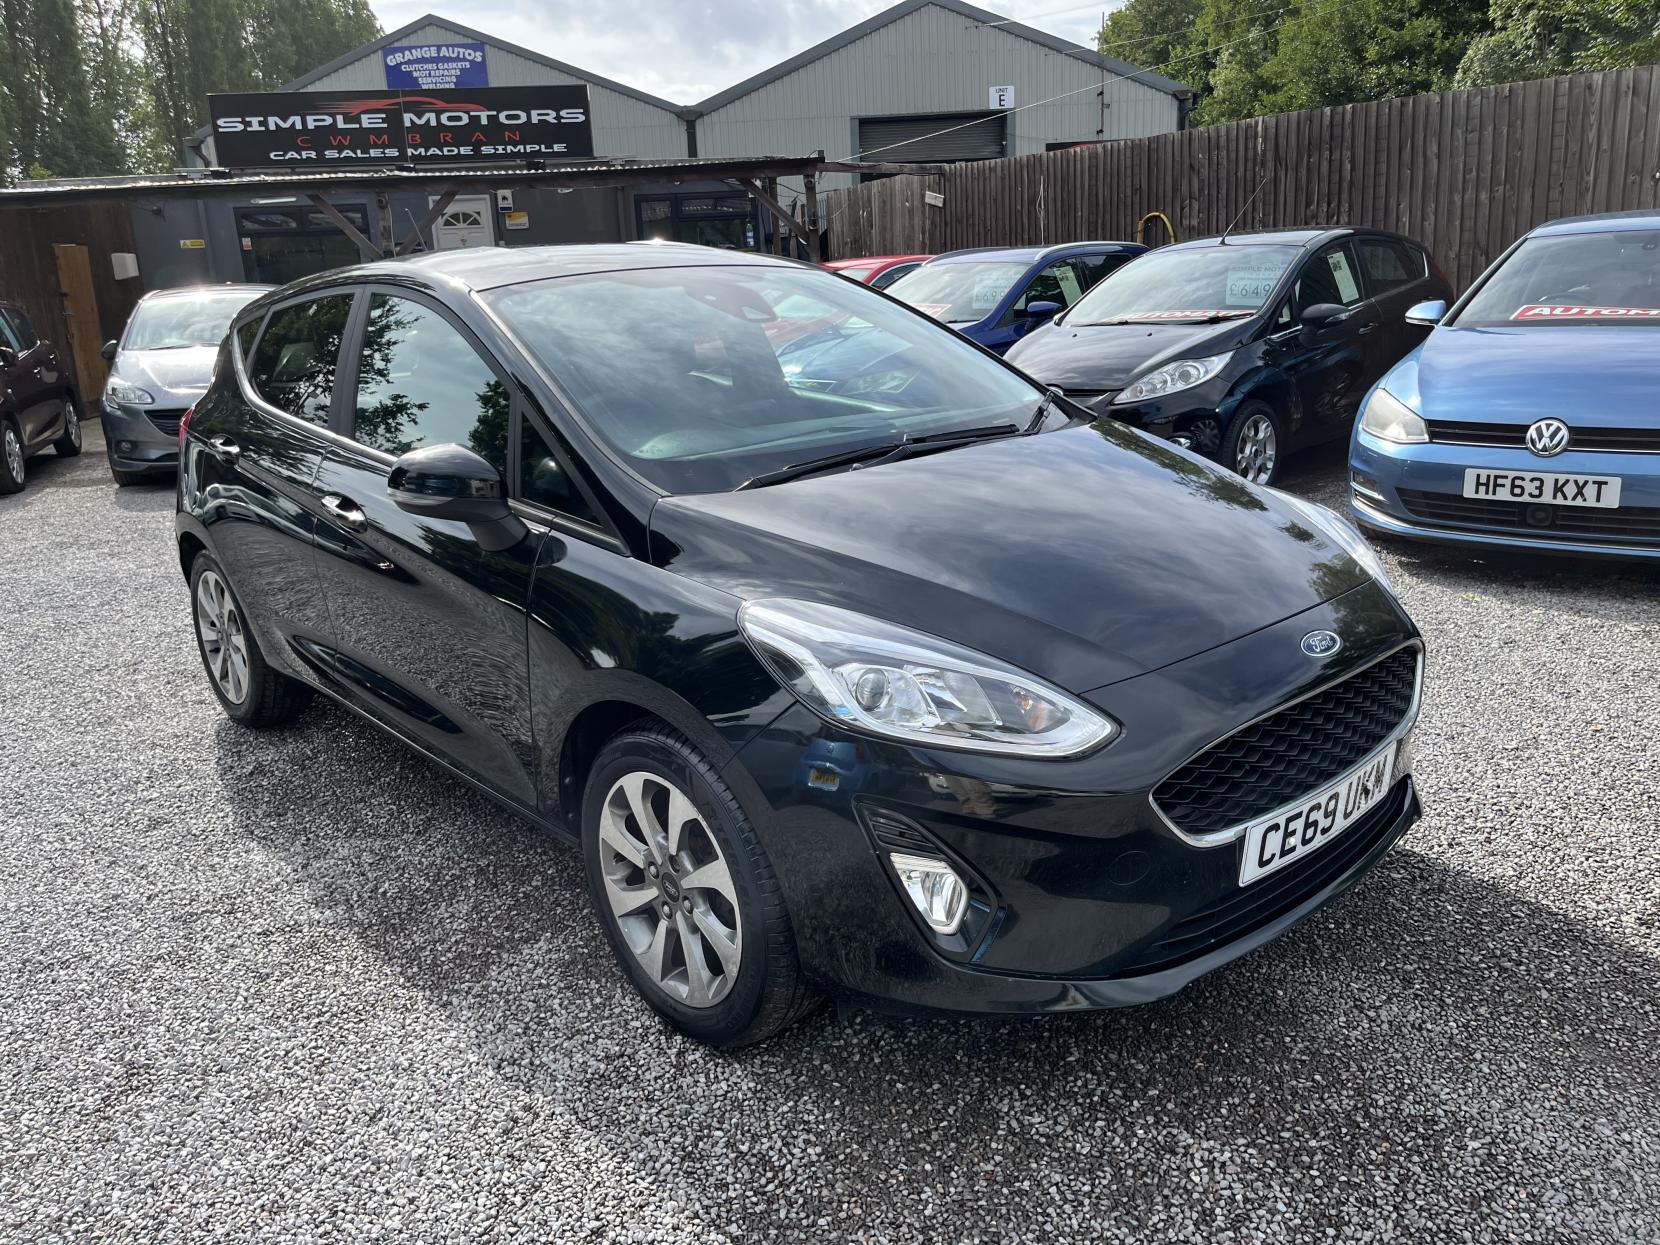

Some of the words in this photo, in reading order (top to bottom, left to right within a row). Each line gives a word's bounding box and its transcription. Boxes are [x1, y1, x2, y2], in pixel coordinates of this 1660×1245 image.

[386, 47, 438, 66] GRANGE
[440, 46, 483, 62] AUTOS
[401, 63, 437, 72] CLUTCHES
[438, 62, 470, 70] GASKETS
[431, 69, 460, 77] REPAIRS
[418, 76, 456, 84] SERVICING
[999, 94, 1005, 107] E
[216, 113, 388, 132] SIMPLE
[403, 109, 586, 127] MOTORS
[269, 150, 317, 160] CAR
[325, 148, 399, 159] SALES
[407, 146, 474, 156] MADE
[481, 143, 568, 154] SIMPLE
[1474, 473, 1545, 499] HF63
[1552, 478, 1609, 503] KXT
[1309, 636, 1333, 652] Ford
[1257, 791, 1340, 869] CE69
